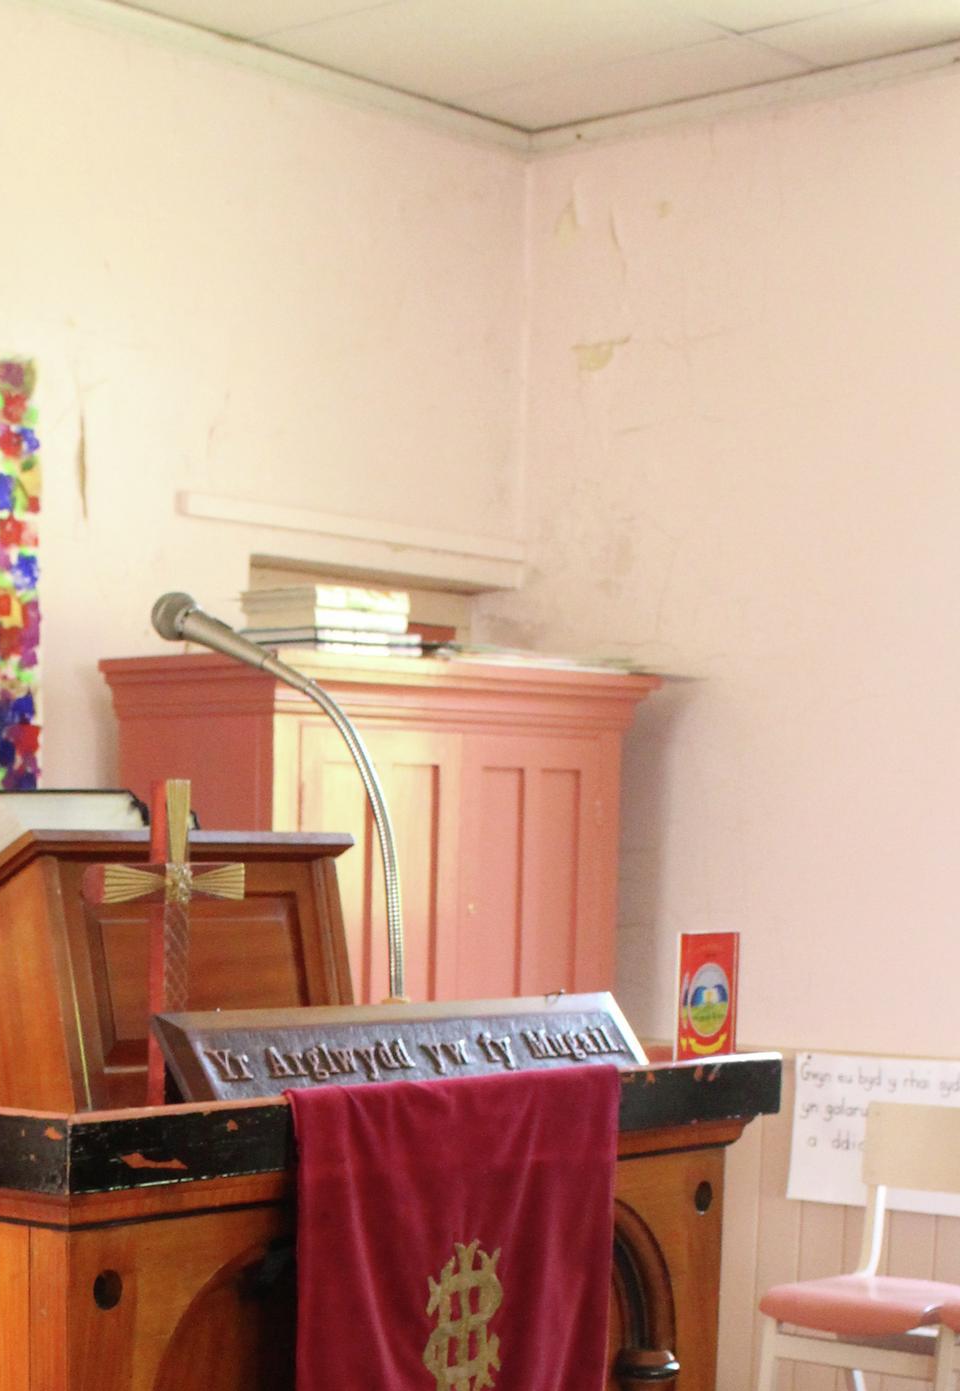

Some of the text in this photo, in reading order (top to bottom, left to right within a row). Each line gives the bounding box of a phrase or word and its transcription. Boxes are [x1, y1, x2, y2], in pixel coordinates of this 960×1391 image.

[204, 1048, 255, 1082] Yr
[265, 1038, 417, 1081] Arglwydd
[419, 1039, 470, 1075] yw
[858, 1066, 882, 1091] byd
